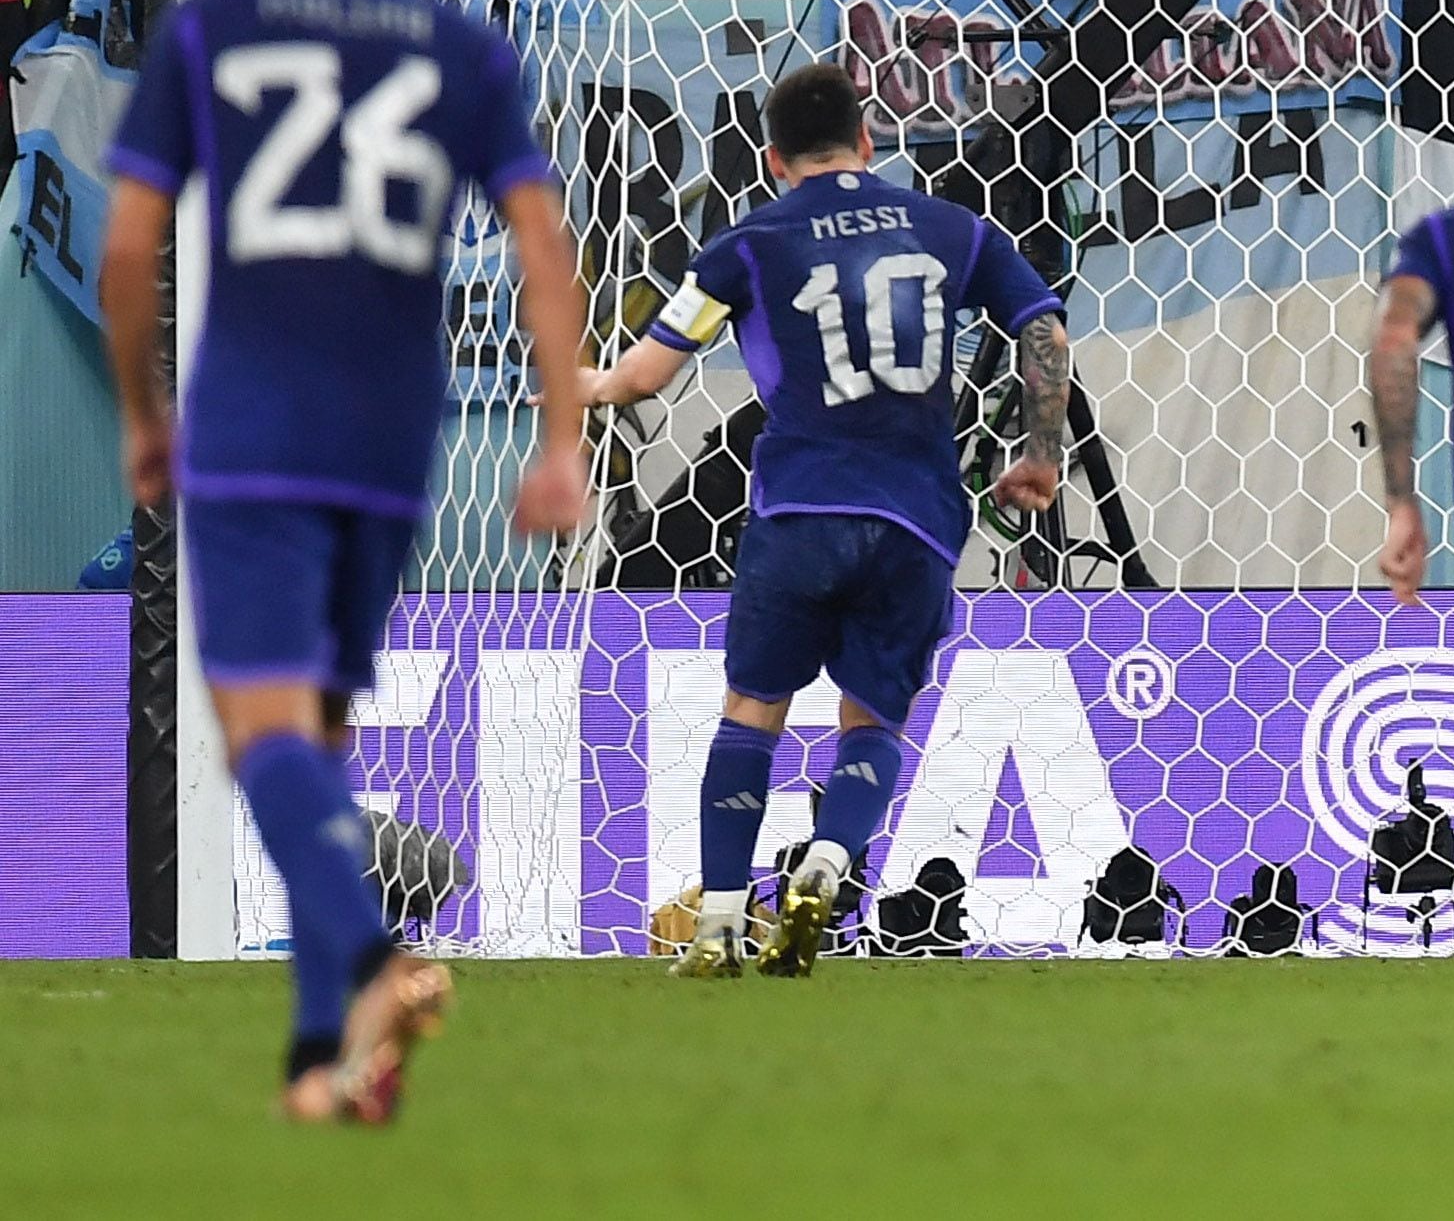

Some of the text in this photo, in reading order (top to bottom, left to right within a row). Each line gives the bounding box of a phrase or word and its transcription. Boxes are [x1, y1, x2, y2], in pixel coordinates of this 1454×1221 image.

[213, 40, 454, 276] 26
[809, 206, 914, 240] MESSI
[791, 253, 949, 408] 10
